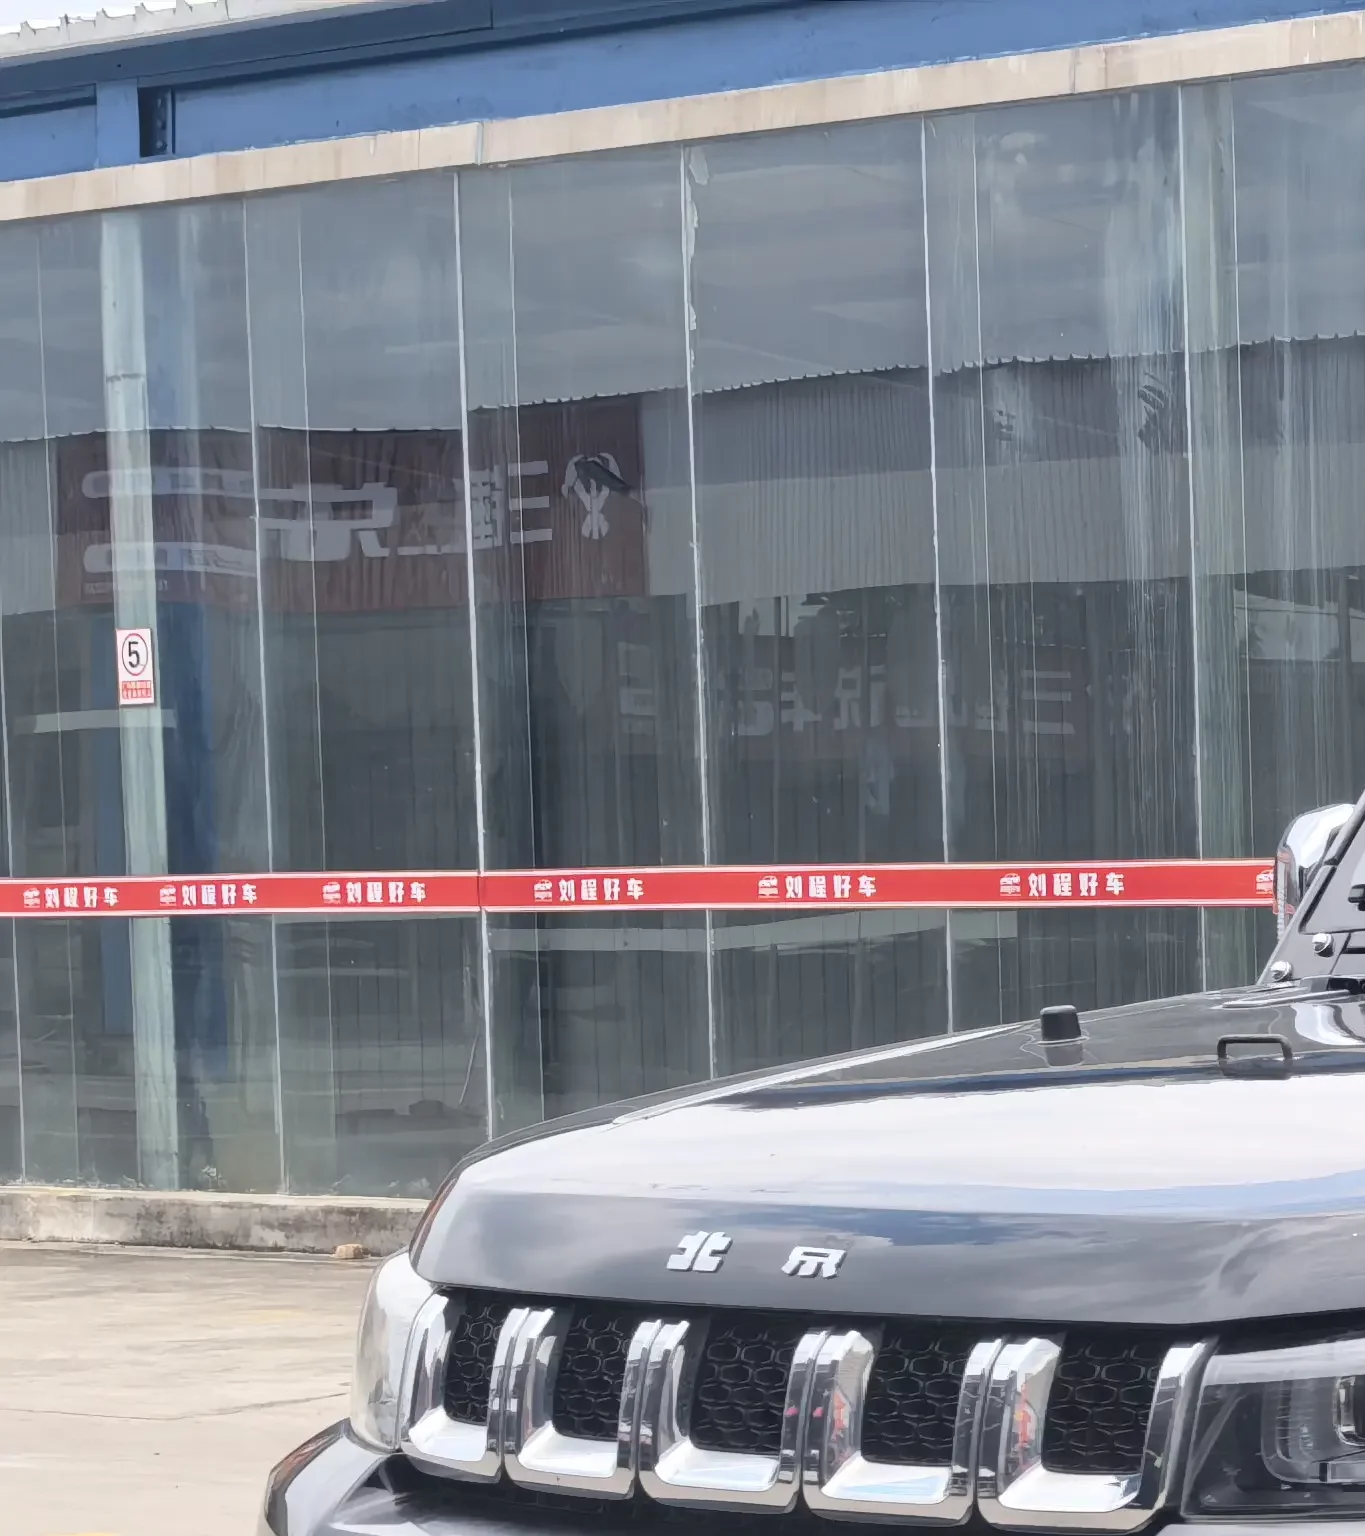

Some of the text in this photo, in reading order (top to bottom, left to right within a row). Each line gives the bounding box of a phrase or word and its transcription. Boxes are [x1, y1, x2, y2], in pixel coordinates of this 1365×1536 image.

[127, 640, 140, 669] 5
[182, 883, 258, 906] 刘程好车
[346, 881, 426, 904] 刘程好车
[559, 877, 644, 902] 刘程好车
[785, 874, 877, 899] 刘程好车
[1028, 871, 1125, 897] 刘程好车
[44, 886, 119, 909] 刘程好车
[666, 1231, 847, 1280] 北京
